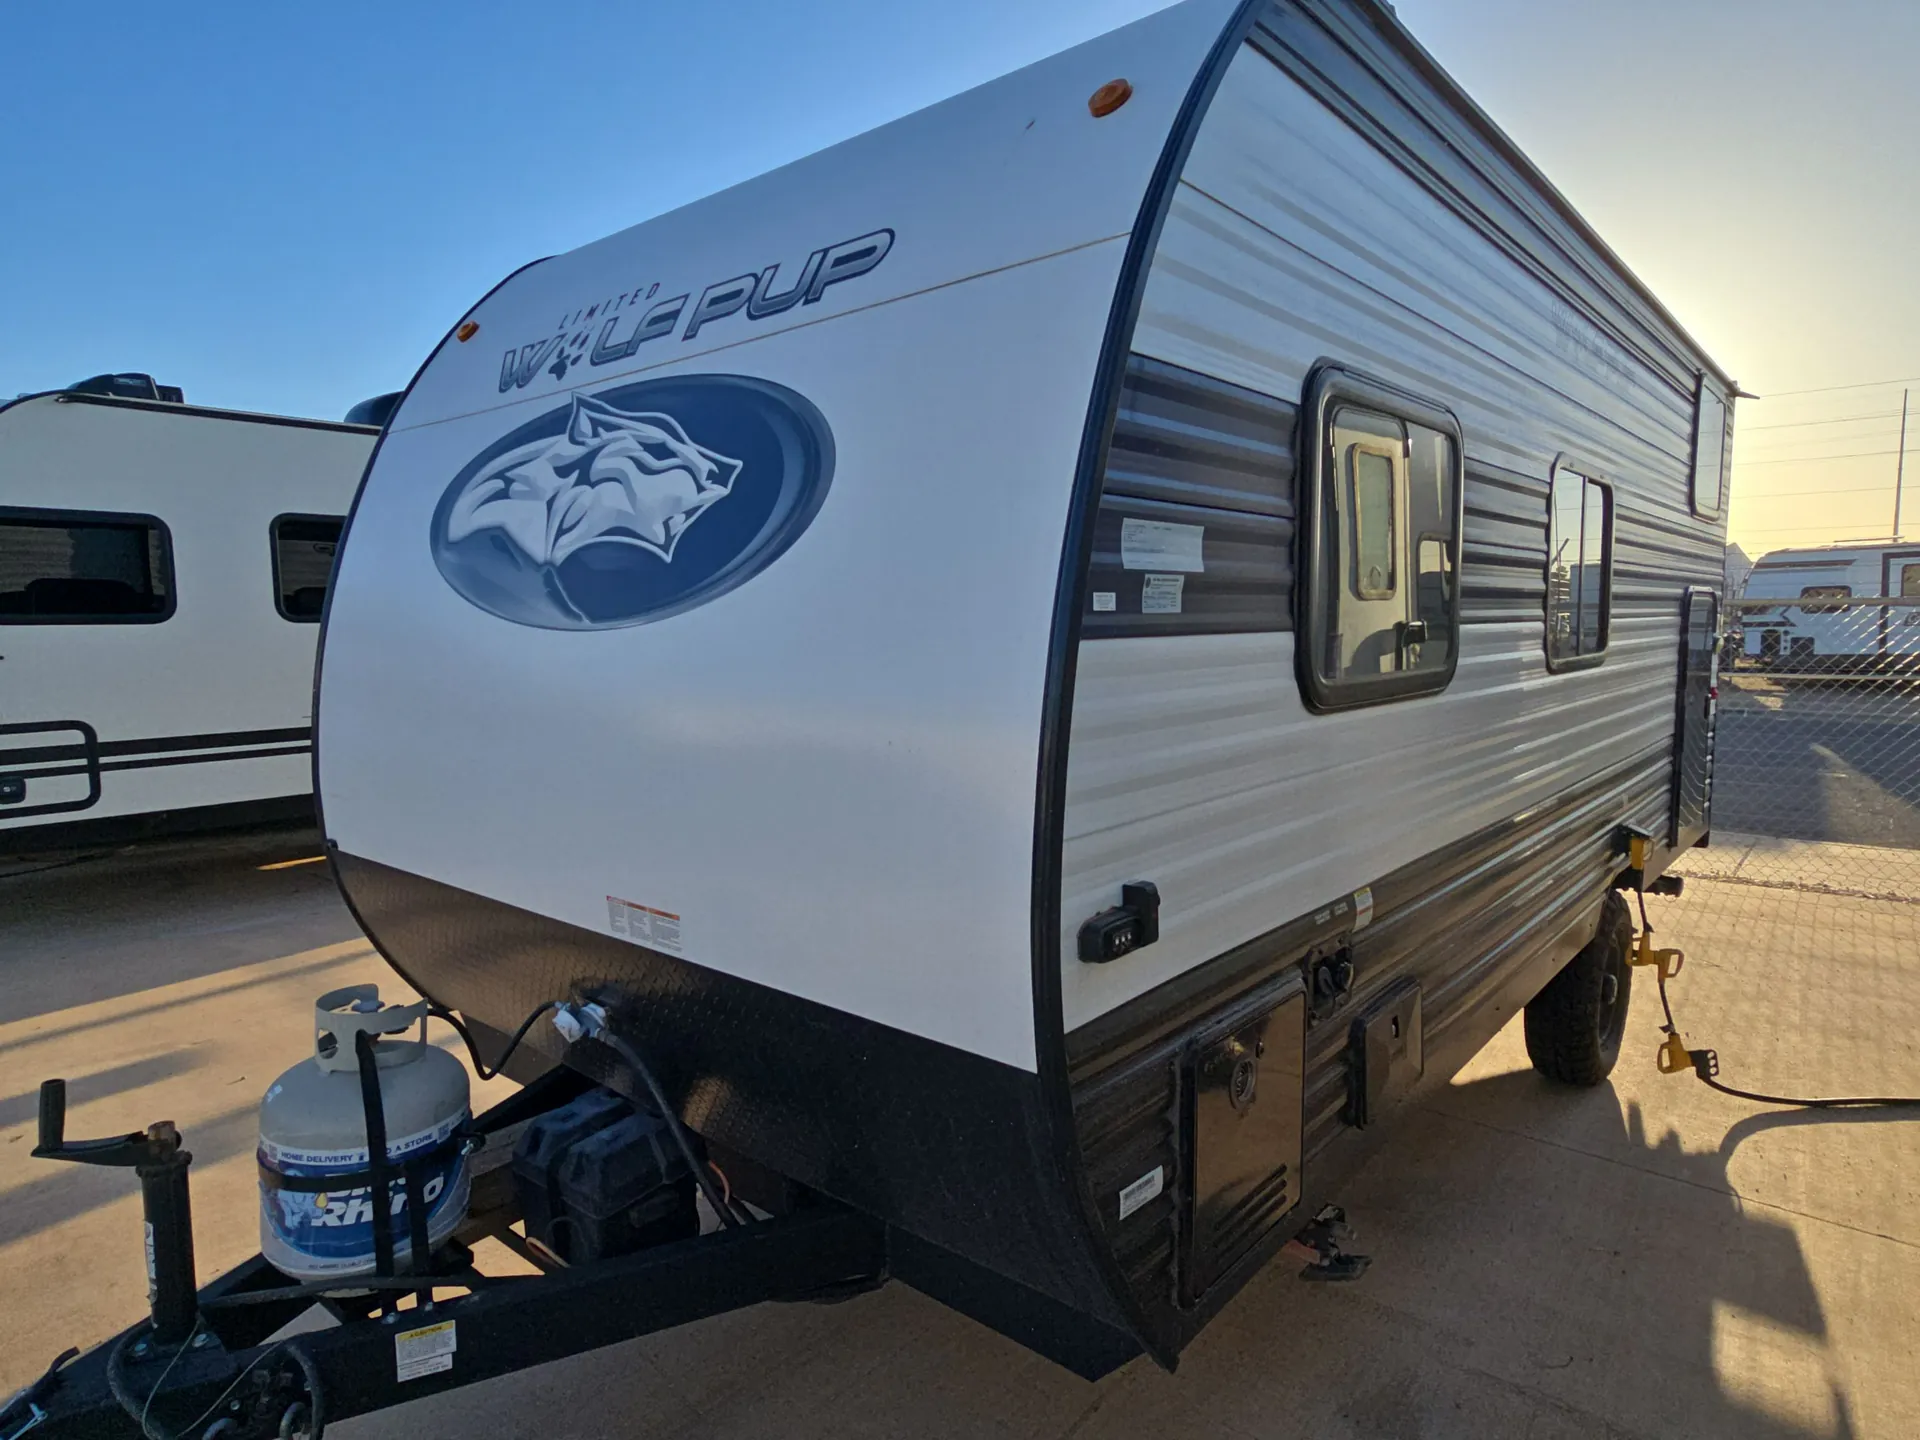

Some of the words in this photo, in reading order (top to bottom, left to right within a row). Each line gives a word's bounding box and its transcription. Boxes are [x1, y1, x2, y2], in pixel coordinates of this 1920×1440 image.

[559, 282, 660, 329] LIMITED
[404, 1132, 434, 1149] STORE
[281, 1151, 305, 1162] HOME
[306, 1153, 354, 1163] DELIVERY
